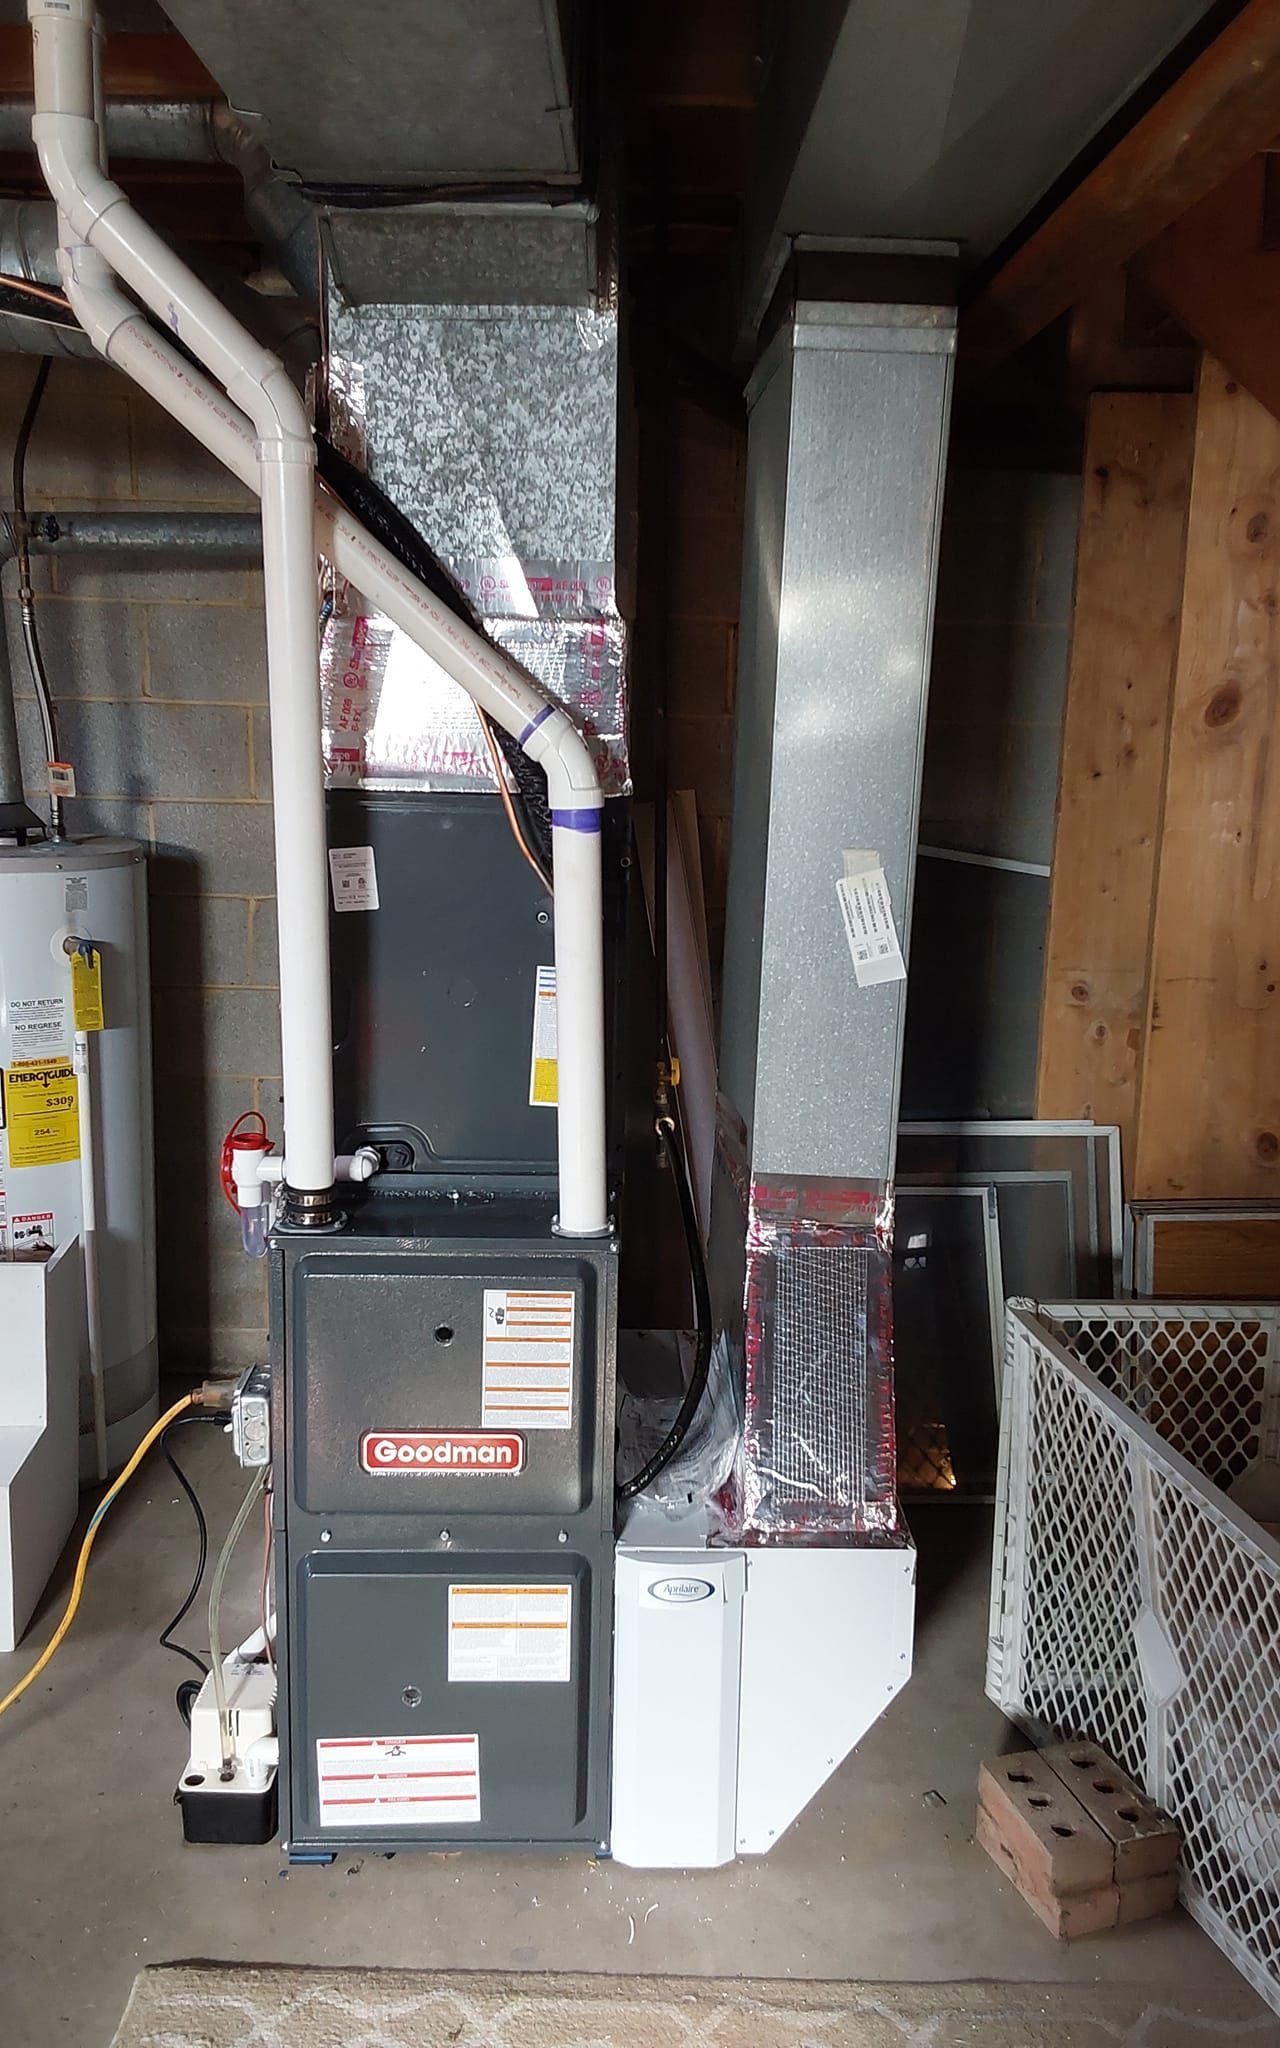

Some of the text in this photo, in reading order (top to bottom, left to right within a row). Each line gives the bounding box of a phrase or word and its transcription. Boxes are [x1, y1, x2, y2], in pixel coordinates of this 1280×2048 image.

[38, 998, 63, 1006] RETURN
[28, 1021, 62, 1030] REGRESE
[34, 1128, 50, 1136] 254
[374, 1440, 512, 1464] Goodman
[664, 1583, 699, 1596] Aprilaire
